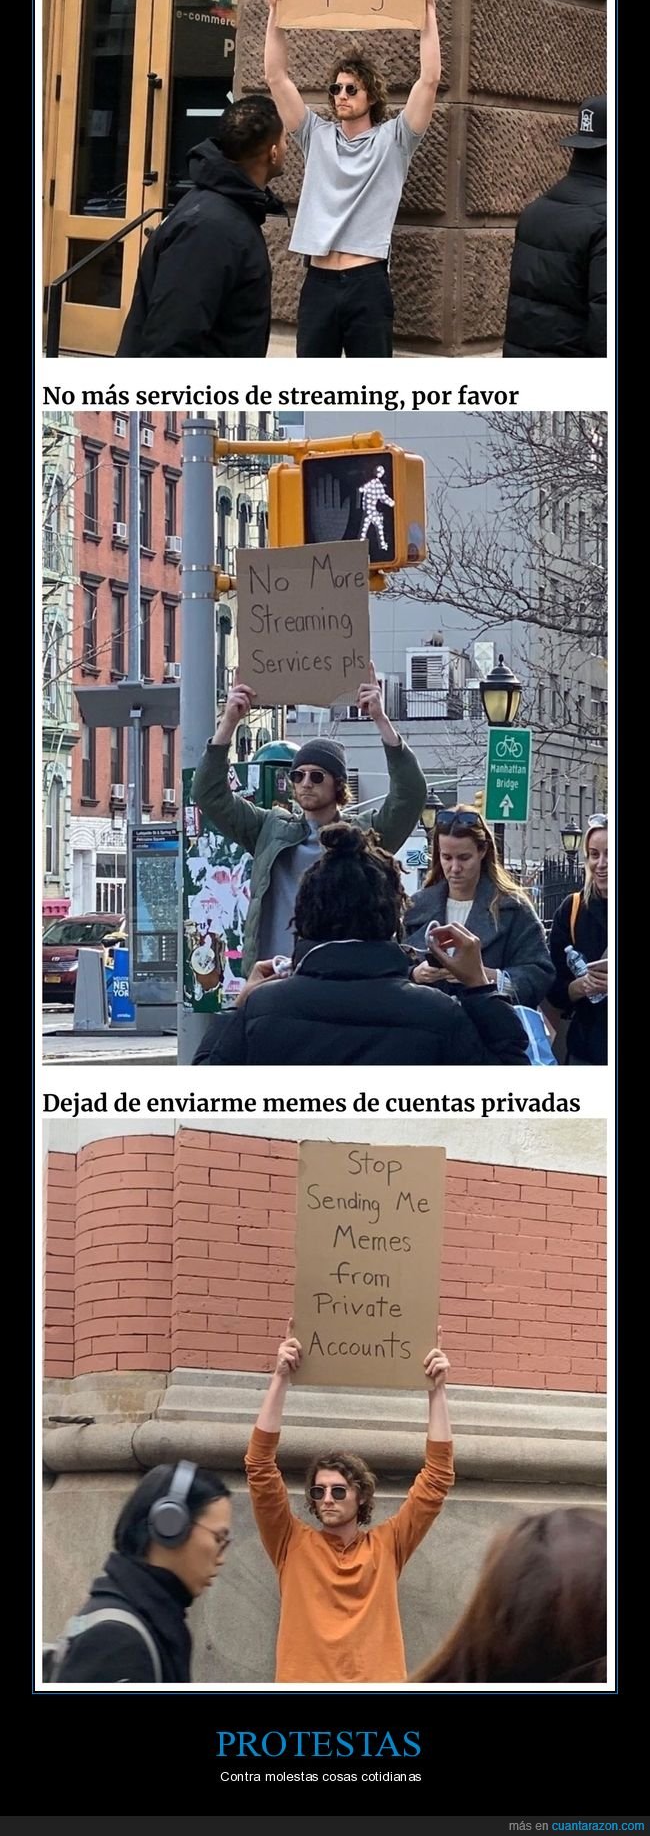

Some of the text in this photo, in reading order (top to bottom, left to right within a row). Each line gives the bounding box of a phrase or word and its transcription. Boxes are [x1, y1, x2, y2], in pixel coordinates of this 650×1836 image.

[176, 10, 237, 27] e-commerc
[249, 553, 366, 595] No More
[250, 604, 353, 639] Streaming
[252, 648, 366, 678] Services pls
[490, 763, 527, 775] Manhattan
[496, 778, 520, 791] Bridge
[347, 1150, 403, 1186] Stop
[306, 1184, 431, 1225] Sending Me
[333, 1224, 412, 1252] Memes
[329, 1261, 390, 1288] from
[313, 1292, 403, 1318] Private
[308, 1331, 412, 1360] Accounts
